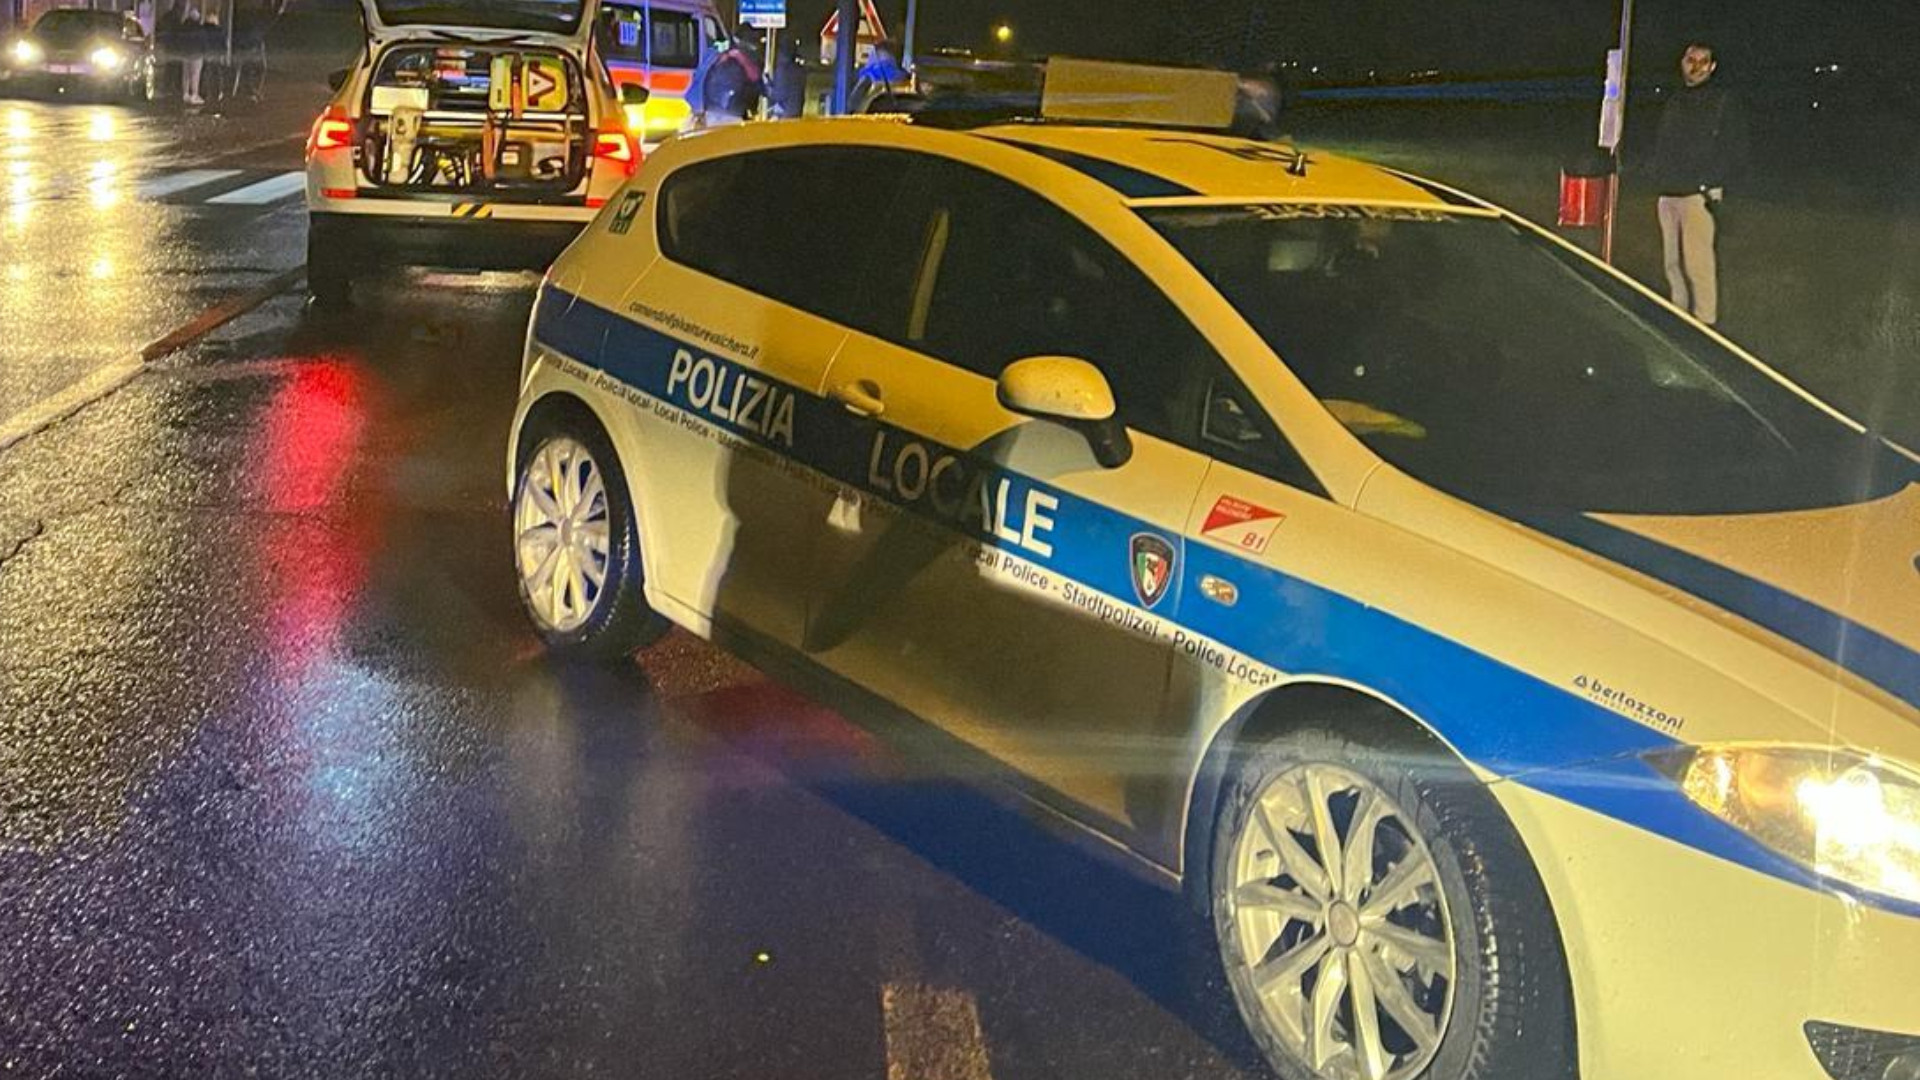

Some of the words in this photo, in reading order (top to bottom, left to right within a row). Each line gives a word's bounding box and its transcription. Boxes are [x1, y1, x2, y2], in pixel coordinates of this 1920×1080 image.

[667, 349, 795, 447] POLIZIA
[869, 431, 1058, 559] LOCALE
[1002, 556, 1049, 590] Police
[1062, 582, 1160, 638] Stadtpolizei
[1173, 631, 1225, 668] Police
[1591, 679, 1685, 730] bertazzoni
